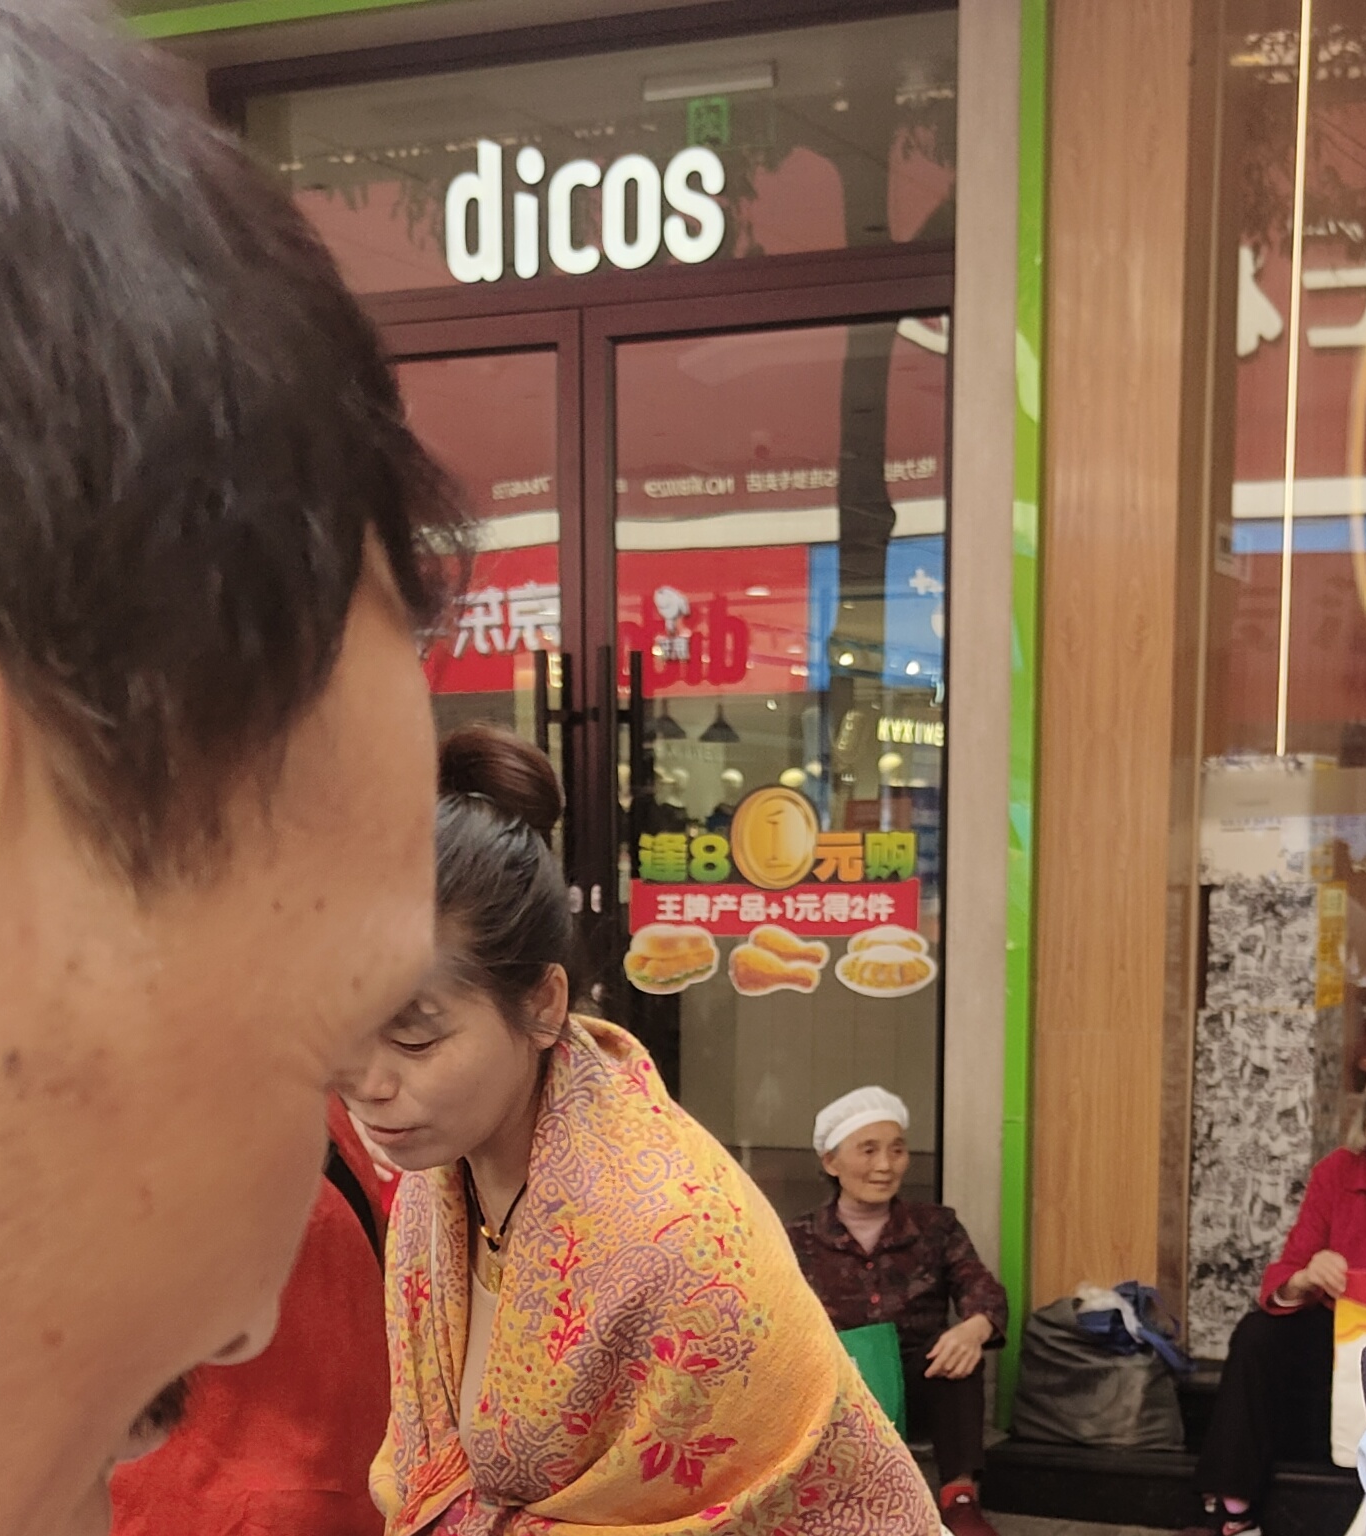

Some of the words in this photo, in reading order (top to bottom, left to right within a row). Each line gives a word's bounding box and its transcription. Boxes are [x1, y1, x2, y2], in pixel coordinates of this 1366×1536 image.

[445, 139, 725, 283] dicos
[656, 893, 895, 922] 王牌产品+1元得2件
